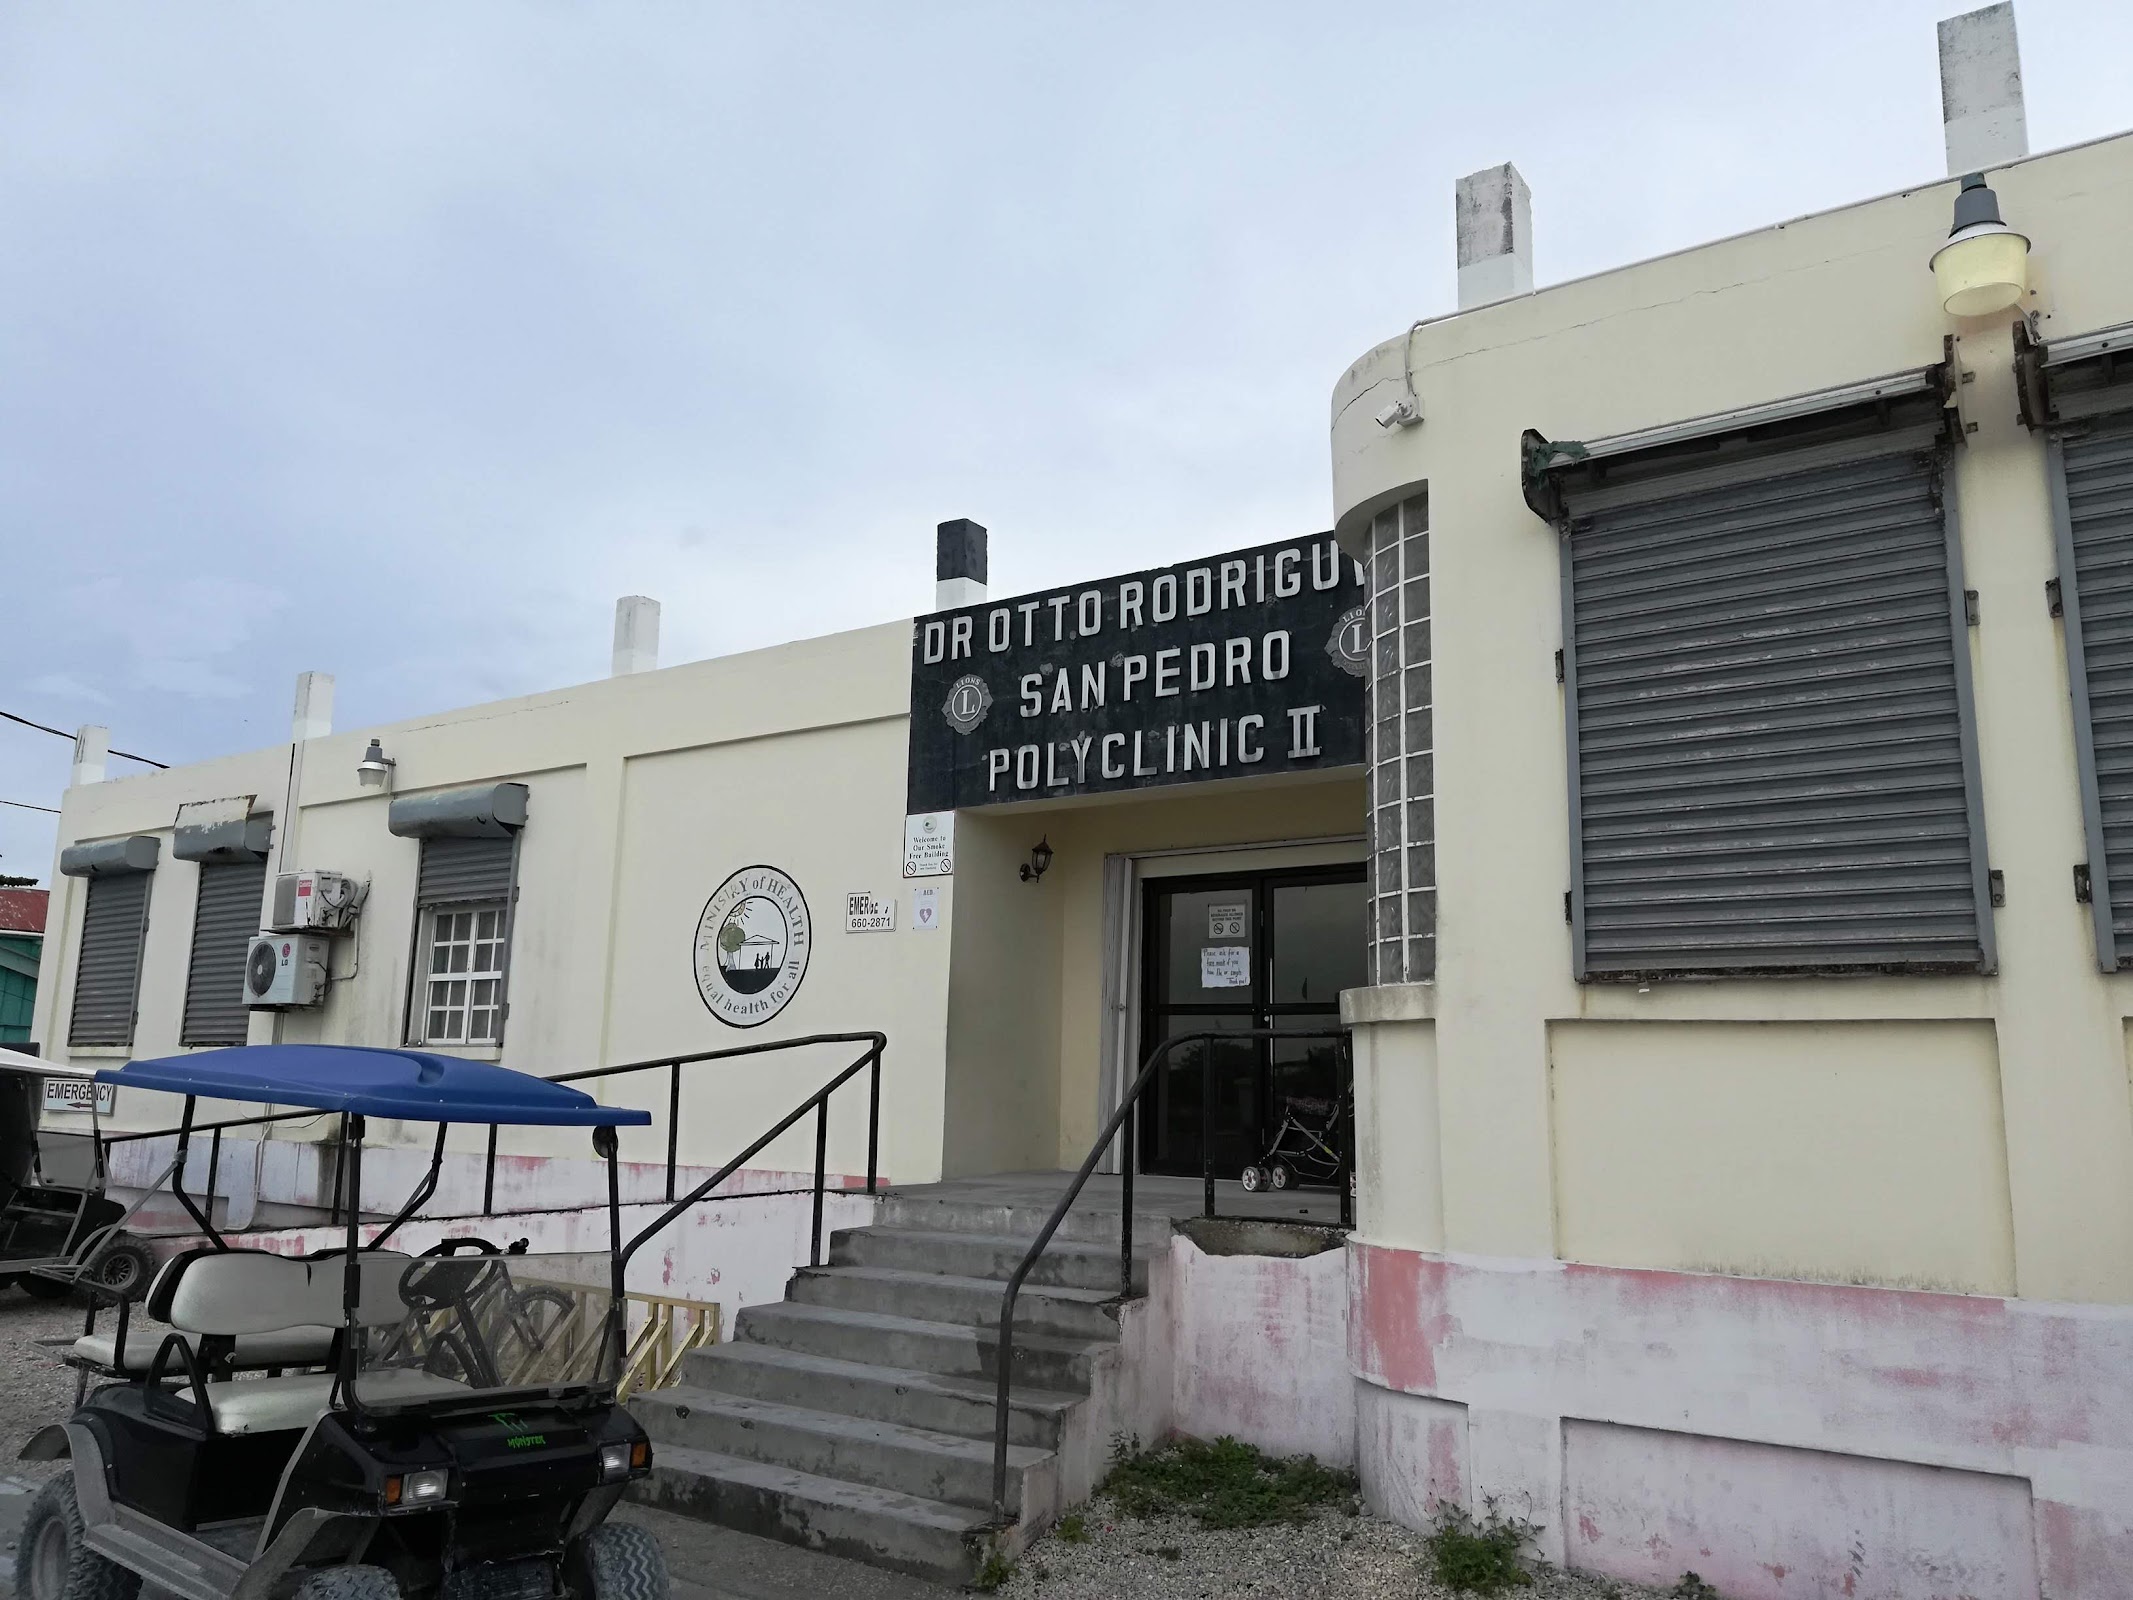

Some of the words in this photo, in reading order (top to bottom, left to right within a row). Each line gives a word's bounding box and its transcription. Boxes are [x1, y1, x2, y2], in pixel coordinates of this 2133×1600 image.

[923, 615, 974, 665] DR
[988, 589, 1102, 654] OTTO
[1119, 540, 1365, 629] RODRIGU
[955, 676, 981, 689] LIONS
[1019, 661, 1106, 718] SAN
[1123, 629, 1290, 702] PEDRO
[961, 690, 976, 715] L
[988, 713, 1265, 792] POLYCLINIC
[1287, 705, 1322, 759] II
[752, 876, 766, 890] of
[767, 878, 804, 946] HEALTH
[851, 917, 890, 928] 660-2871
[723, 999, 769, 1014] health
[770, 983, 790, 1003] for
[788, 960, 800, 980] all
[507, 1435, 547, 1449] MONSTER
